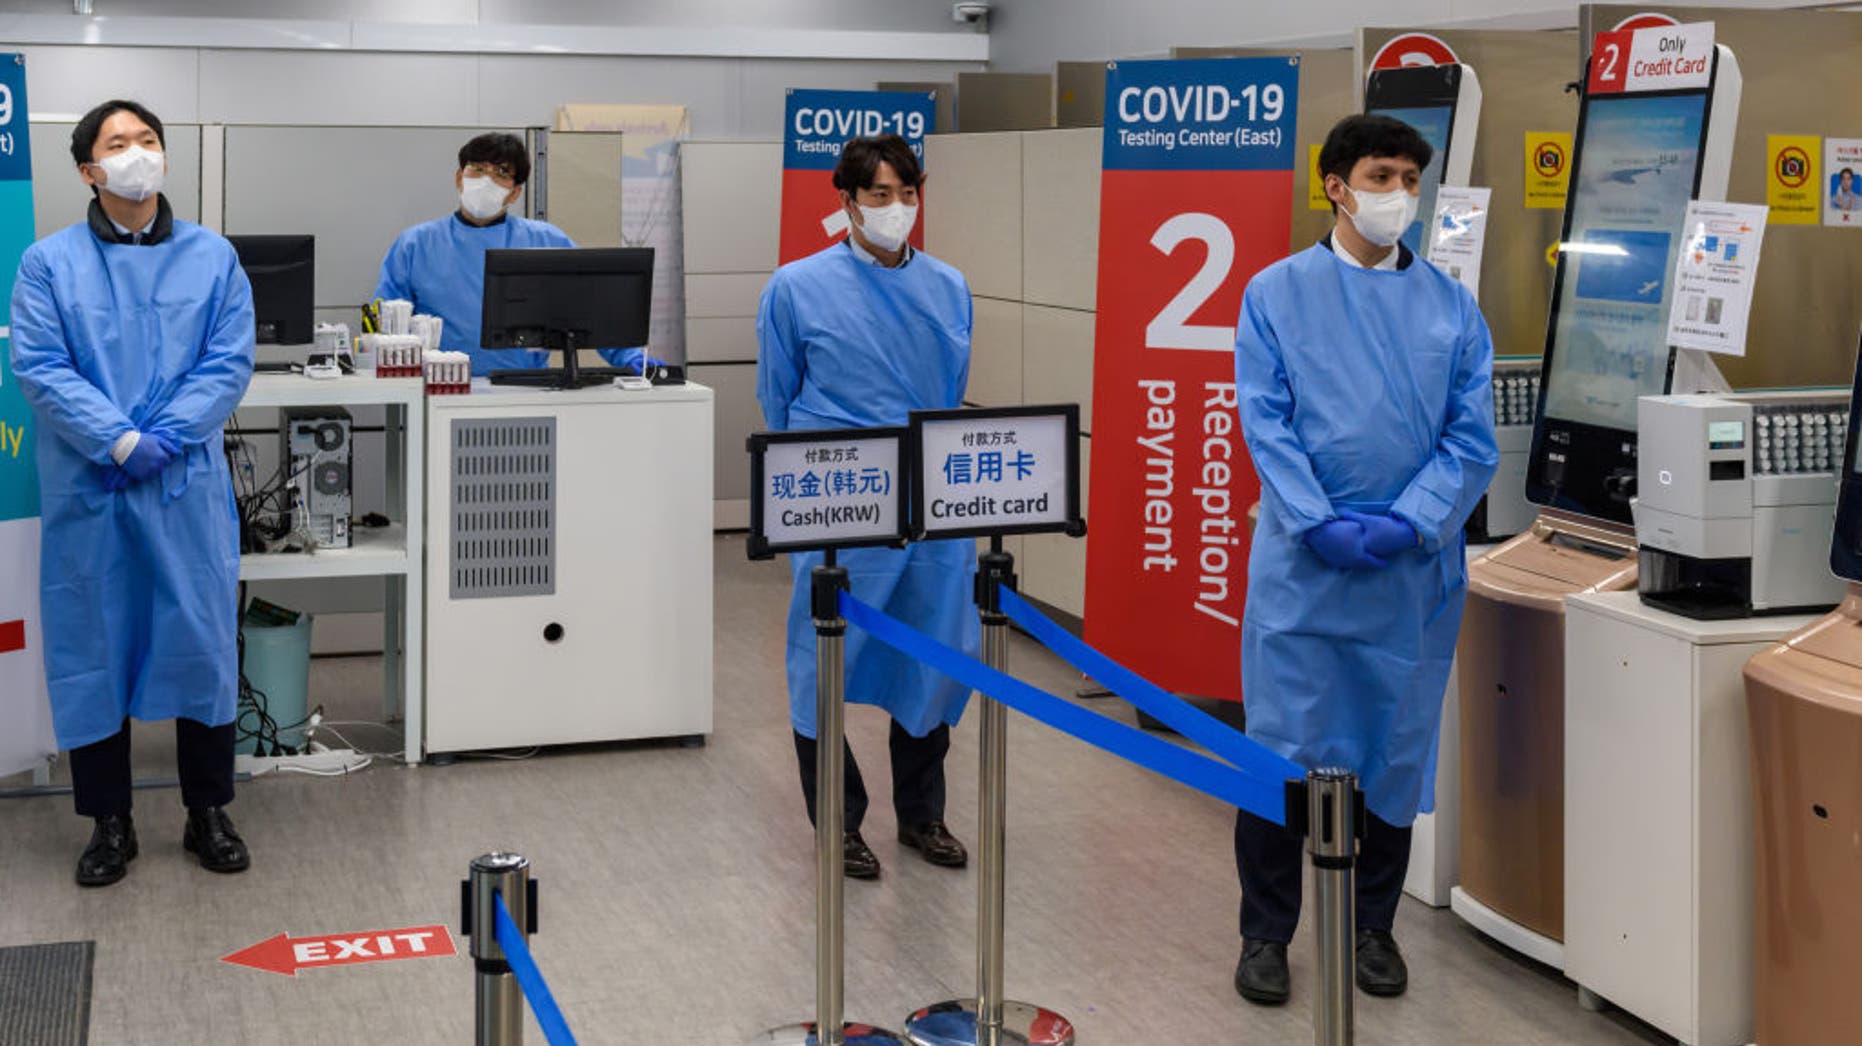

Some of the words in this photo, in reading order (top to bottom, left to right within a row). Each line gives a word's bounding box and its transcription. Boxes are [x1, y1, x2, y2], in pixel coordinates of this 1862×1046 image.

[1659, 36, 1686, 54] Only
[1601, 44, 1619, 81] 2
[1633, 58, 1673, 78] Credit
[1674, 56, 1706, 74] Card
[1118, 83, 1285, 123] COVID-19
[794, 107, 925, 138] COVID-19
[1118, 128, 1175, 150] Testing
[1178, 128, 1233, 147] Center
[1234, 126, 1282, 149] (East)
[795, 139, 841, 157] Testing
[1145, 212, 1236, 352] 2
[962, 430, 1018, 447] 付款方式
[804, 446, 859, 464] 付款方式
[943, 449, 1036, 485] 信用卡
[771, 466, 891, 501] 现金(韩元)
[1136, 379, 1178, 573] payment
[781, 503, 881, 528] Cash(KRW)
[931, 494, 997, 519] Credit
[1002, 493, 1049, 515] card
[1192, 381, 1239, 627] Reception/
[292, 931, 434, 963] EXIT
